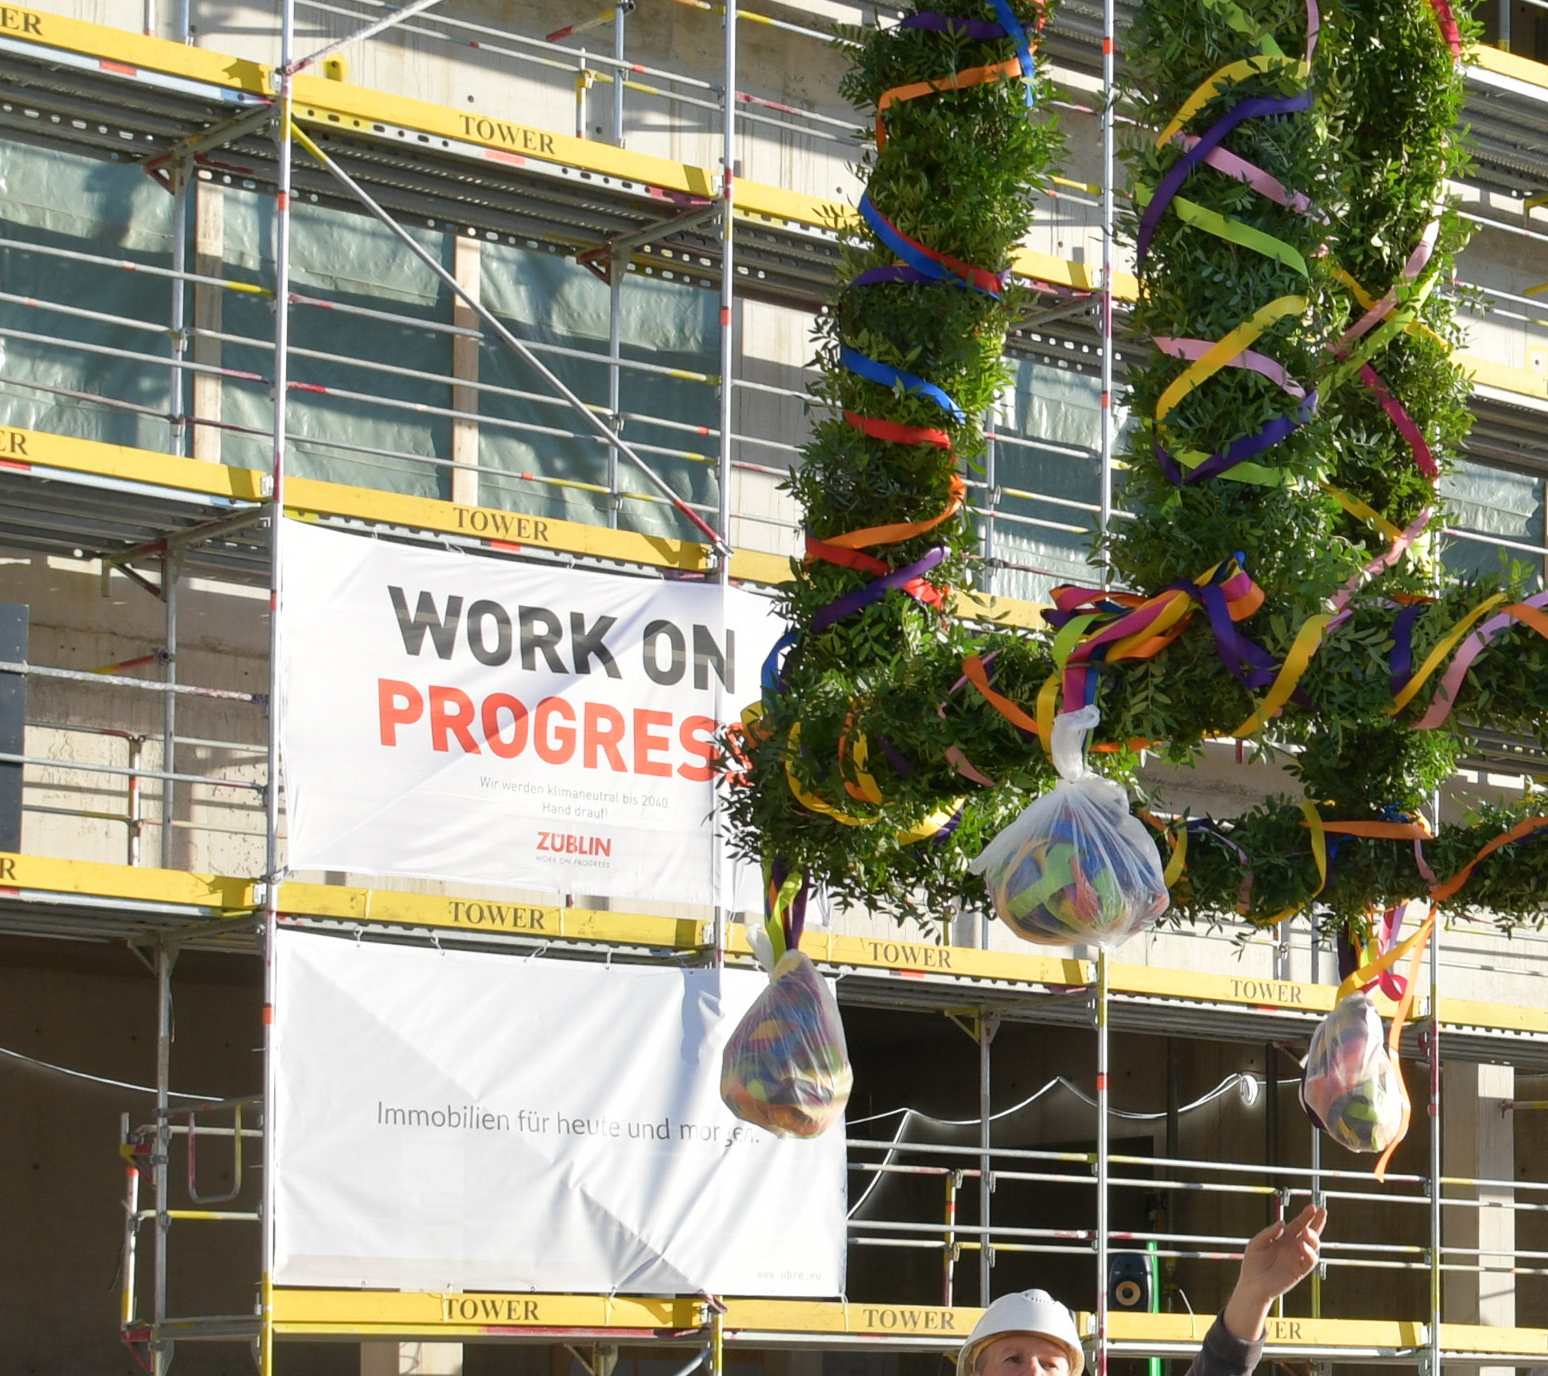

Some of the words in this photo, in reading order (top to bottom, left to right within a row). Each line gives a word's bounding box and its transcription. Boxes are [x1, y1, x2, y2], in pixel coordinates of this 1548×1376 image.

[459, 115, 554, 153] TOWER
[452, 505, 550, 542] TOWER
[387, 585, 622, 679] WORK
[642, 619, 735, 694] ON
[479, 775, 498, 790] Wir
[502, 780, 544, 795] werden
[547, 785, 619, 803] klimaneutral
[622, 792, 639, 806] bis
[542, 801, 571, 816] Hand
[574, 804, 609, 819] drauf!
[536, 830, 612, 857] ZÜBLIN
[449, 900, 546, 932] TOWER
[869, 942, 953, 968] TOWER
[1230, 979, 1302, 1004] TOWER
[377, 1100, 510, 1132] Immobilien
[517, 1109, 551, 1135] für
[556, 1111, 620, 1138] heute
[628, 1116, 670, 1141] und
[444, 1295, 539, 1322] TOWER
[863, 1306, 956, 1331] TOWER
